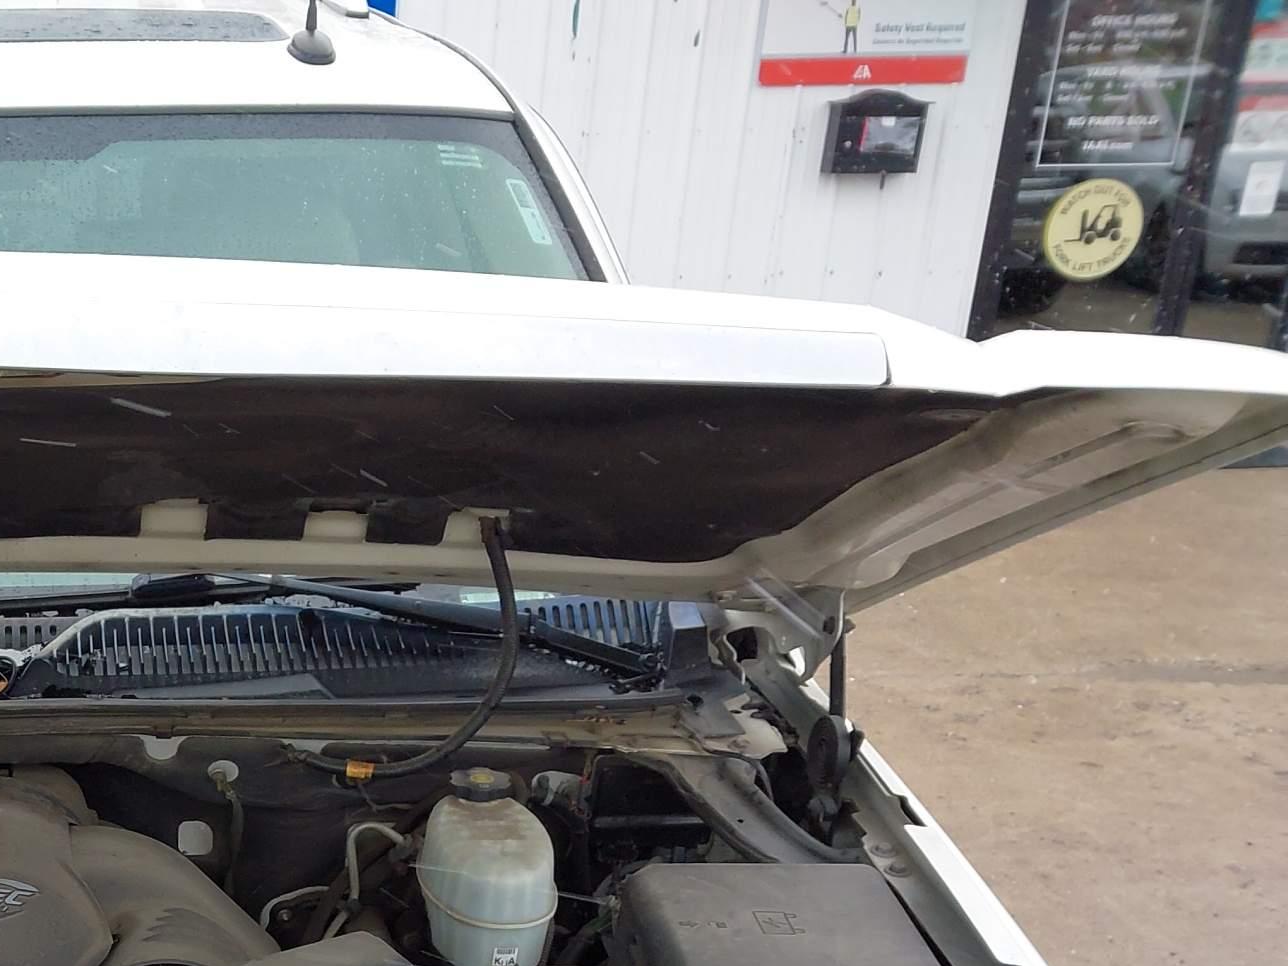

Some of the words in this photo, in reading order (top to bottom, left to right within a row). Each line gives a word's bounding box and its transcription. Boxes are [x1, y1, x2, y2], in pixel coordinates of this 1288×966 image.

[875, 23, 903, 35] Safety
[905, 21, 924, 32] Vest
[926, 22, 966, 34] Required
[1071, 262, 1095, 272] LIFT
